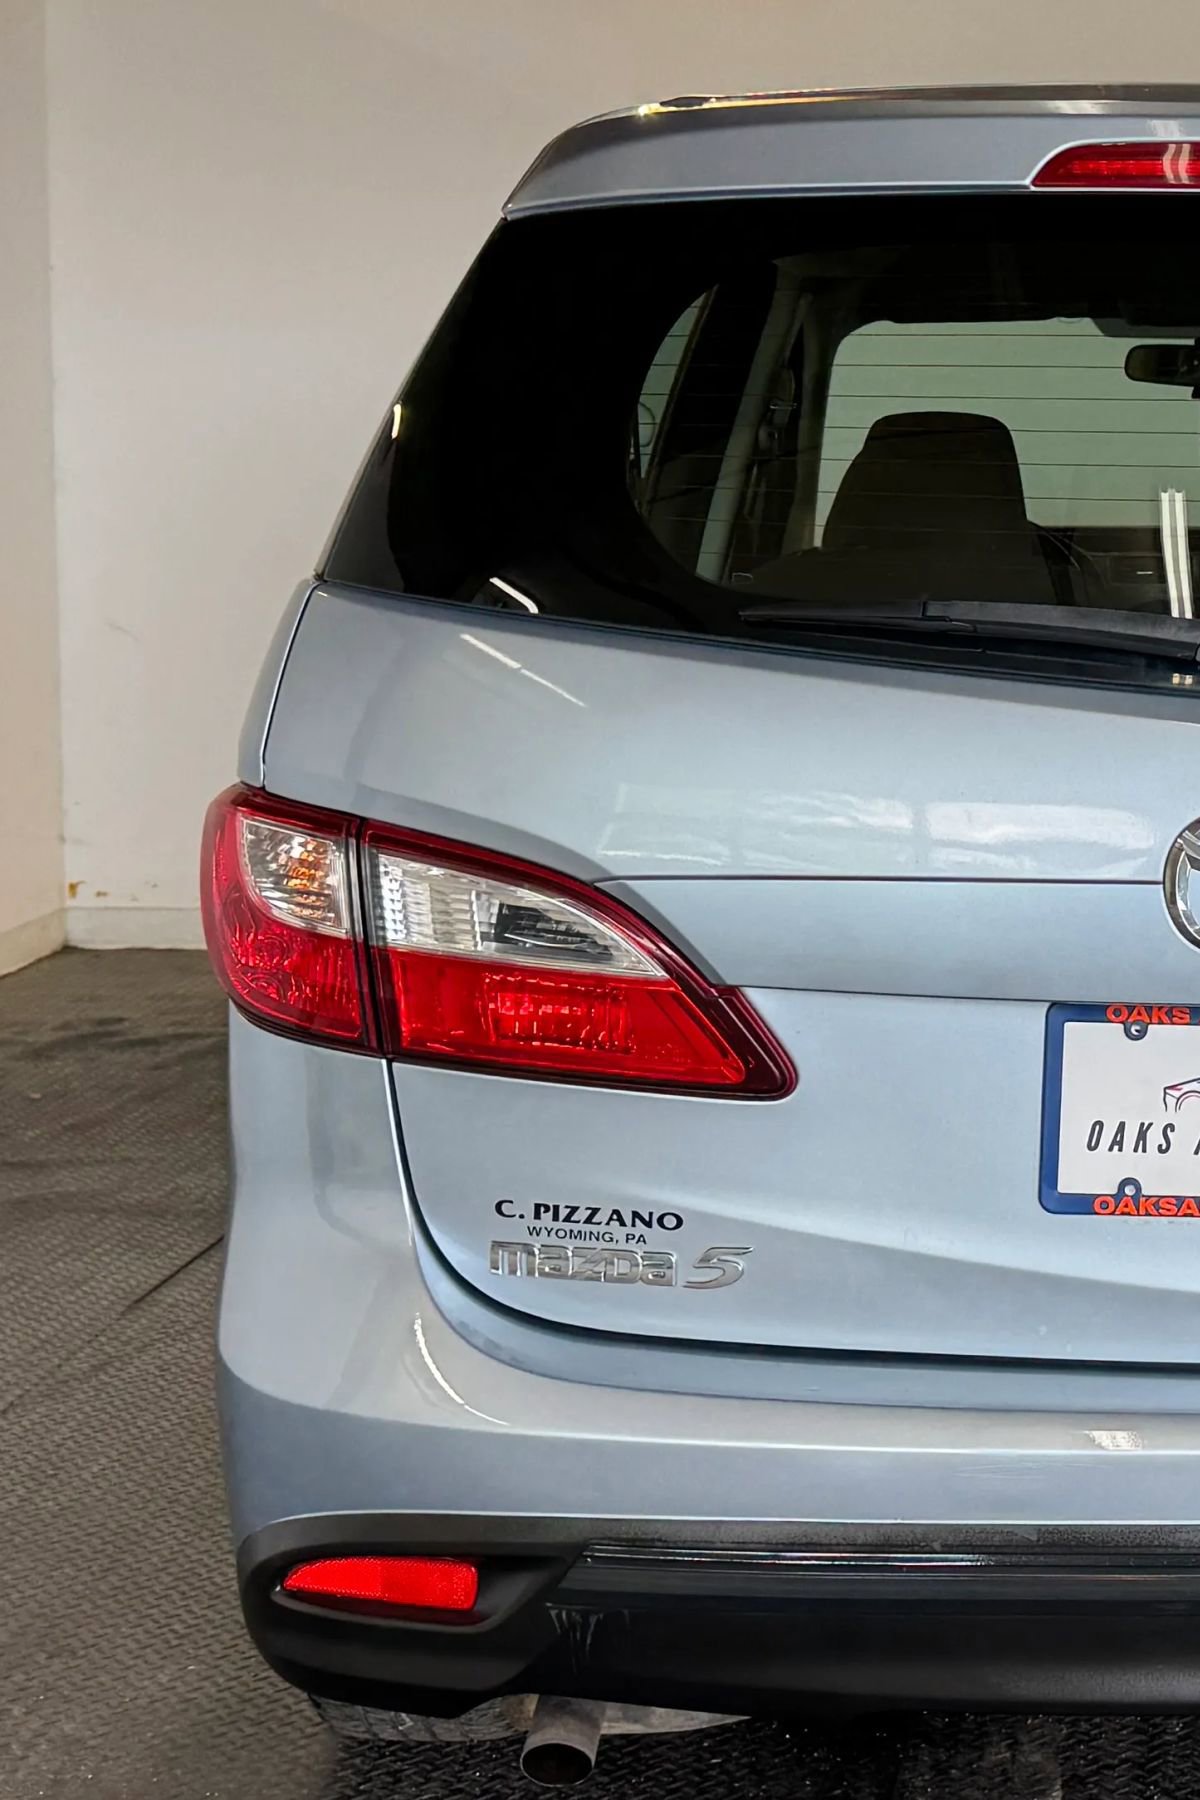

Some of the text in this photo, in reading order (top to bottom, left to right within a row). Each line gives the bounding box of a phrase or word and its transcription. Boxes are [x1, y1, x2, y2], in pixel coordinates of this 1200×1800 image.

[1106, 1004, 1191, 1024] OAKS
[1087, 1120, 1176, 1155] OAKS
[495, 1199, 684, 1231] C. PIZZANO
[527, 1226, 647, 1245] WYOMING, PA
[682, 1246, 753, 1289] 5
